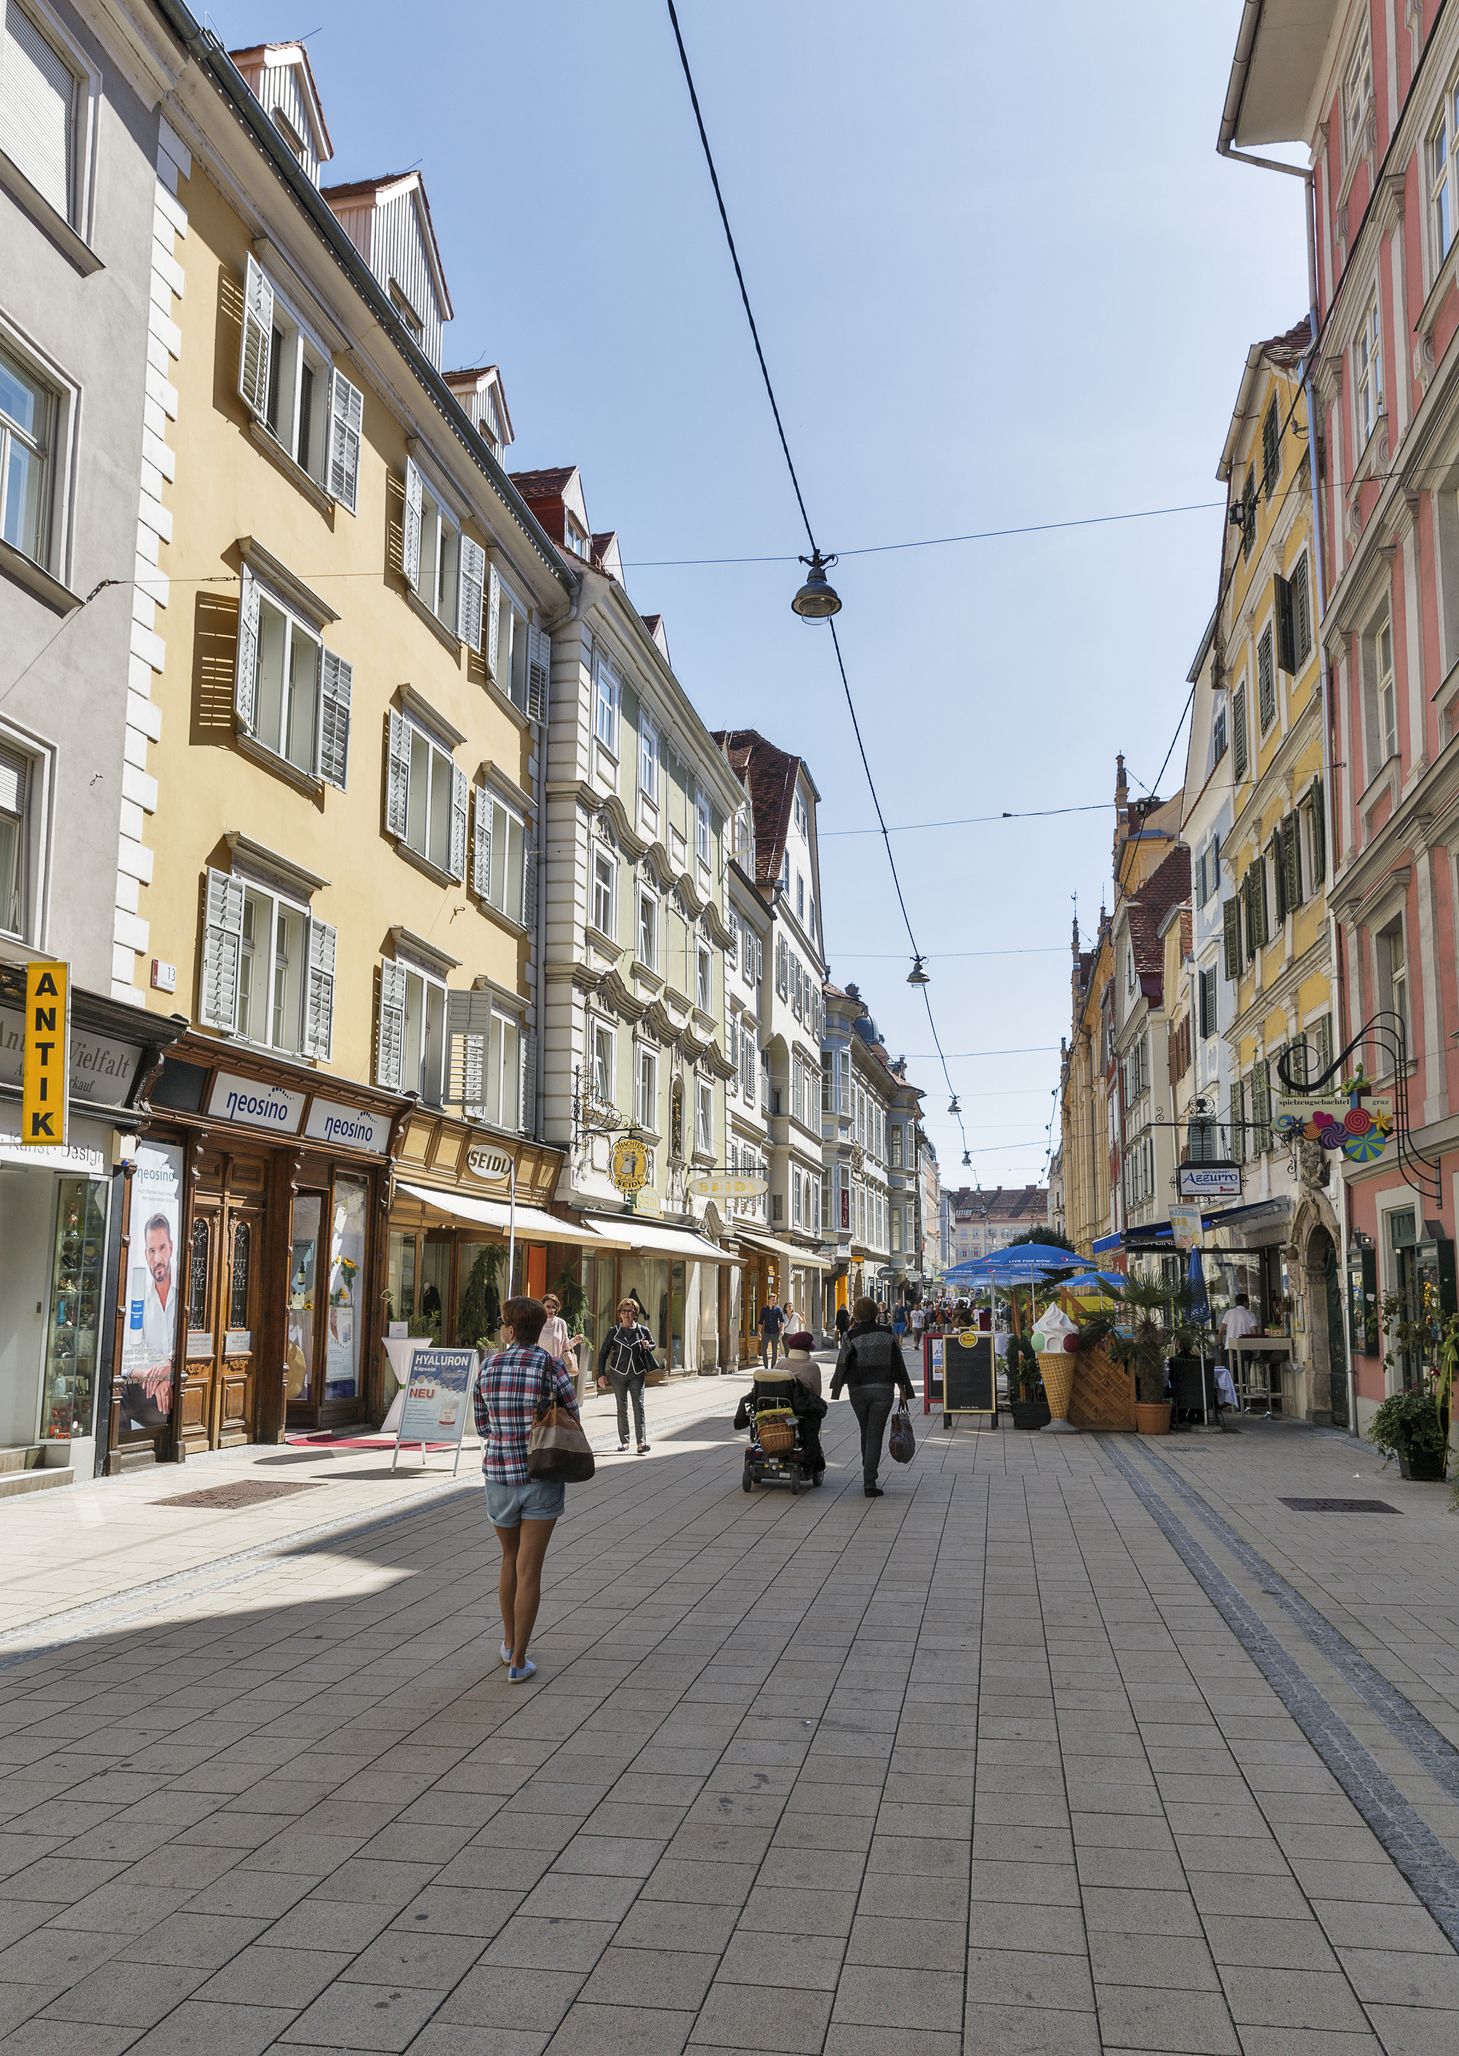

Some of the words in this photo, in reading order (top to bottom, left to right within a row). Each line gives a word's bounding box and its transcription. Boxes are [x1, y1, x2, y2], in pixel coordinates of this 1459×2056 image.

[168, 966, 176, 982] 13
[31, 972, 58, 1136] ANTIK
[70, 1040, 130, 1078] Vielfalt
[1278, 1098, 1350, 1106] spielzeugschachtel
[616, 1140, 646, 1150] TRACHTEN
[61, 1142, 104, 1166] Design
[469, 1150, 507, 1173] SEIDL
[617, 1179, 643, 1188] SEIDL
[1182, 1172, 1238, 1185] Azzurro
[415, 1354, 469, 1366] HYALURON
[409, 1387, 436, 1399] NEU
